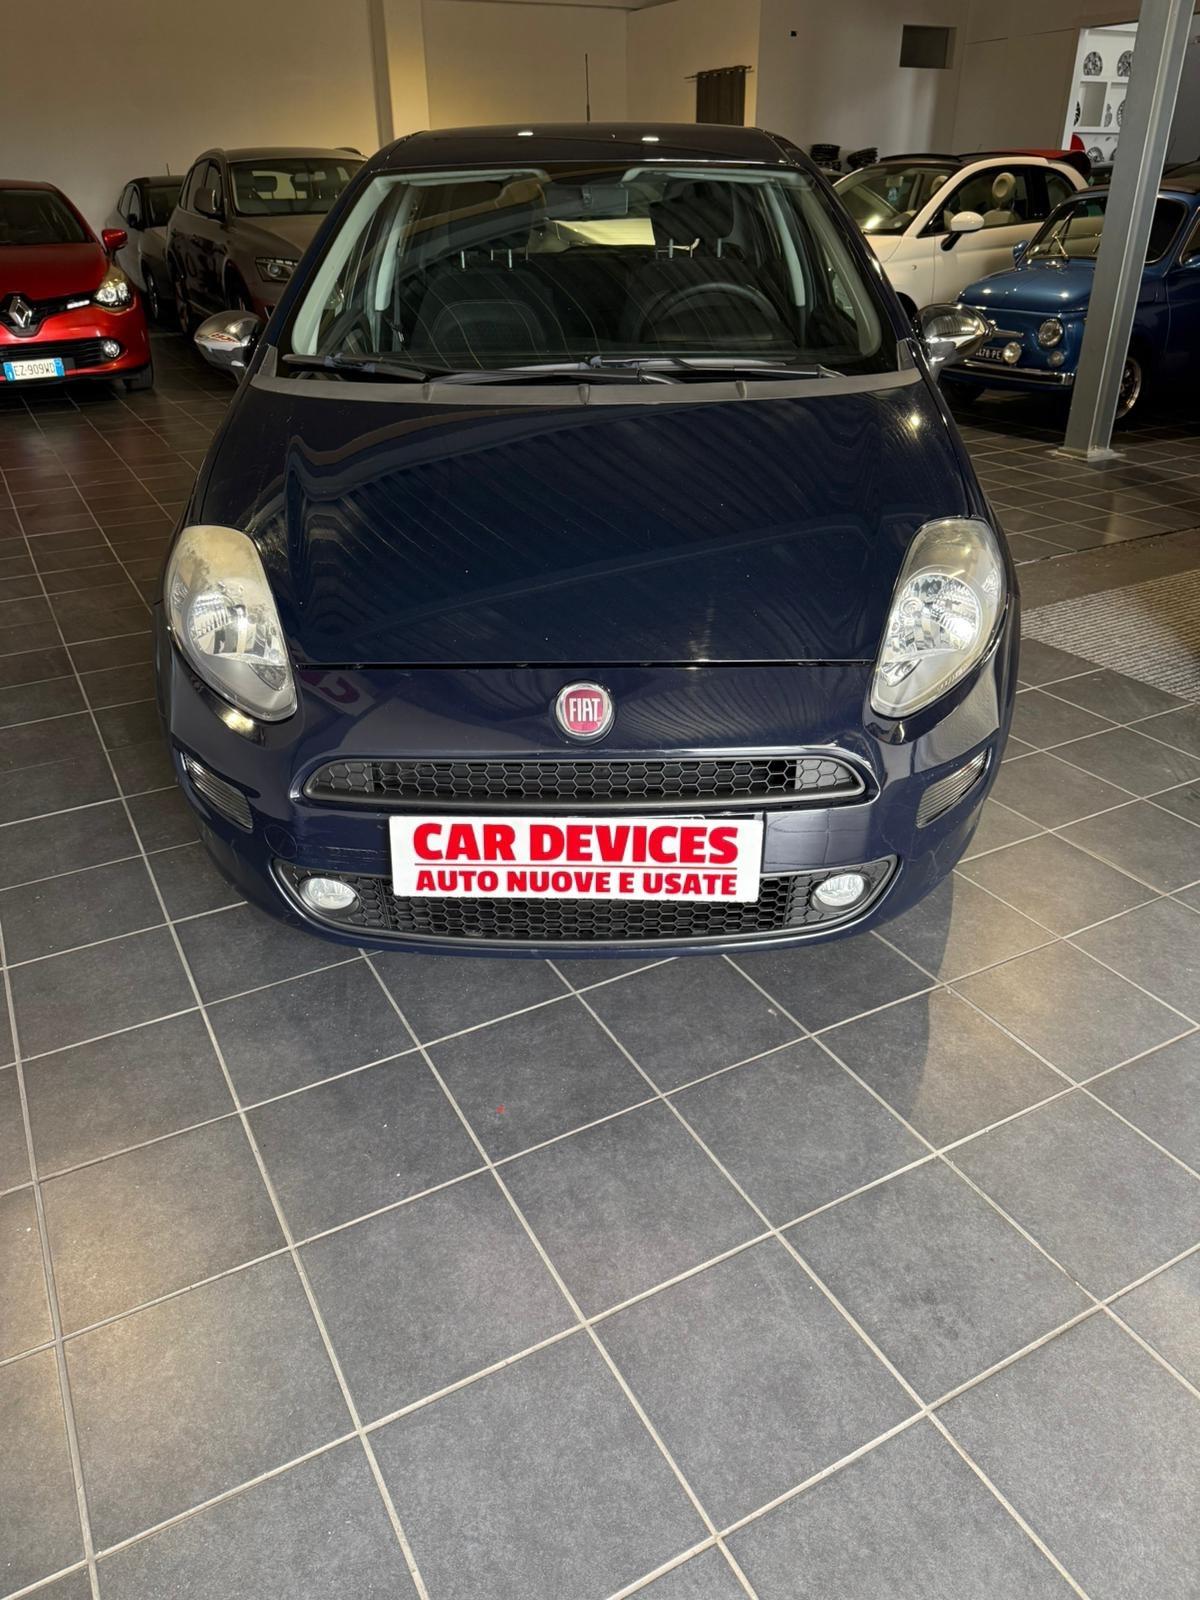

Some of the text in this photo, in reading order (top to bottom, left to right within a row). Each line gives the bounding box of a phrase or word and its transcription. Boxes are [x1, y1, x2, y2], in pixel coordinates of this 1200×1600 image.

[568, 697, 601, 722] FIAT
[413, 823, 738, 864] CAR DEVICES
[416, 870, 737, 896] AUTO NUOVE E USATE
